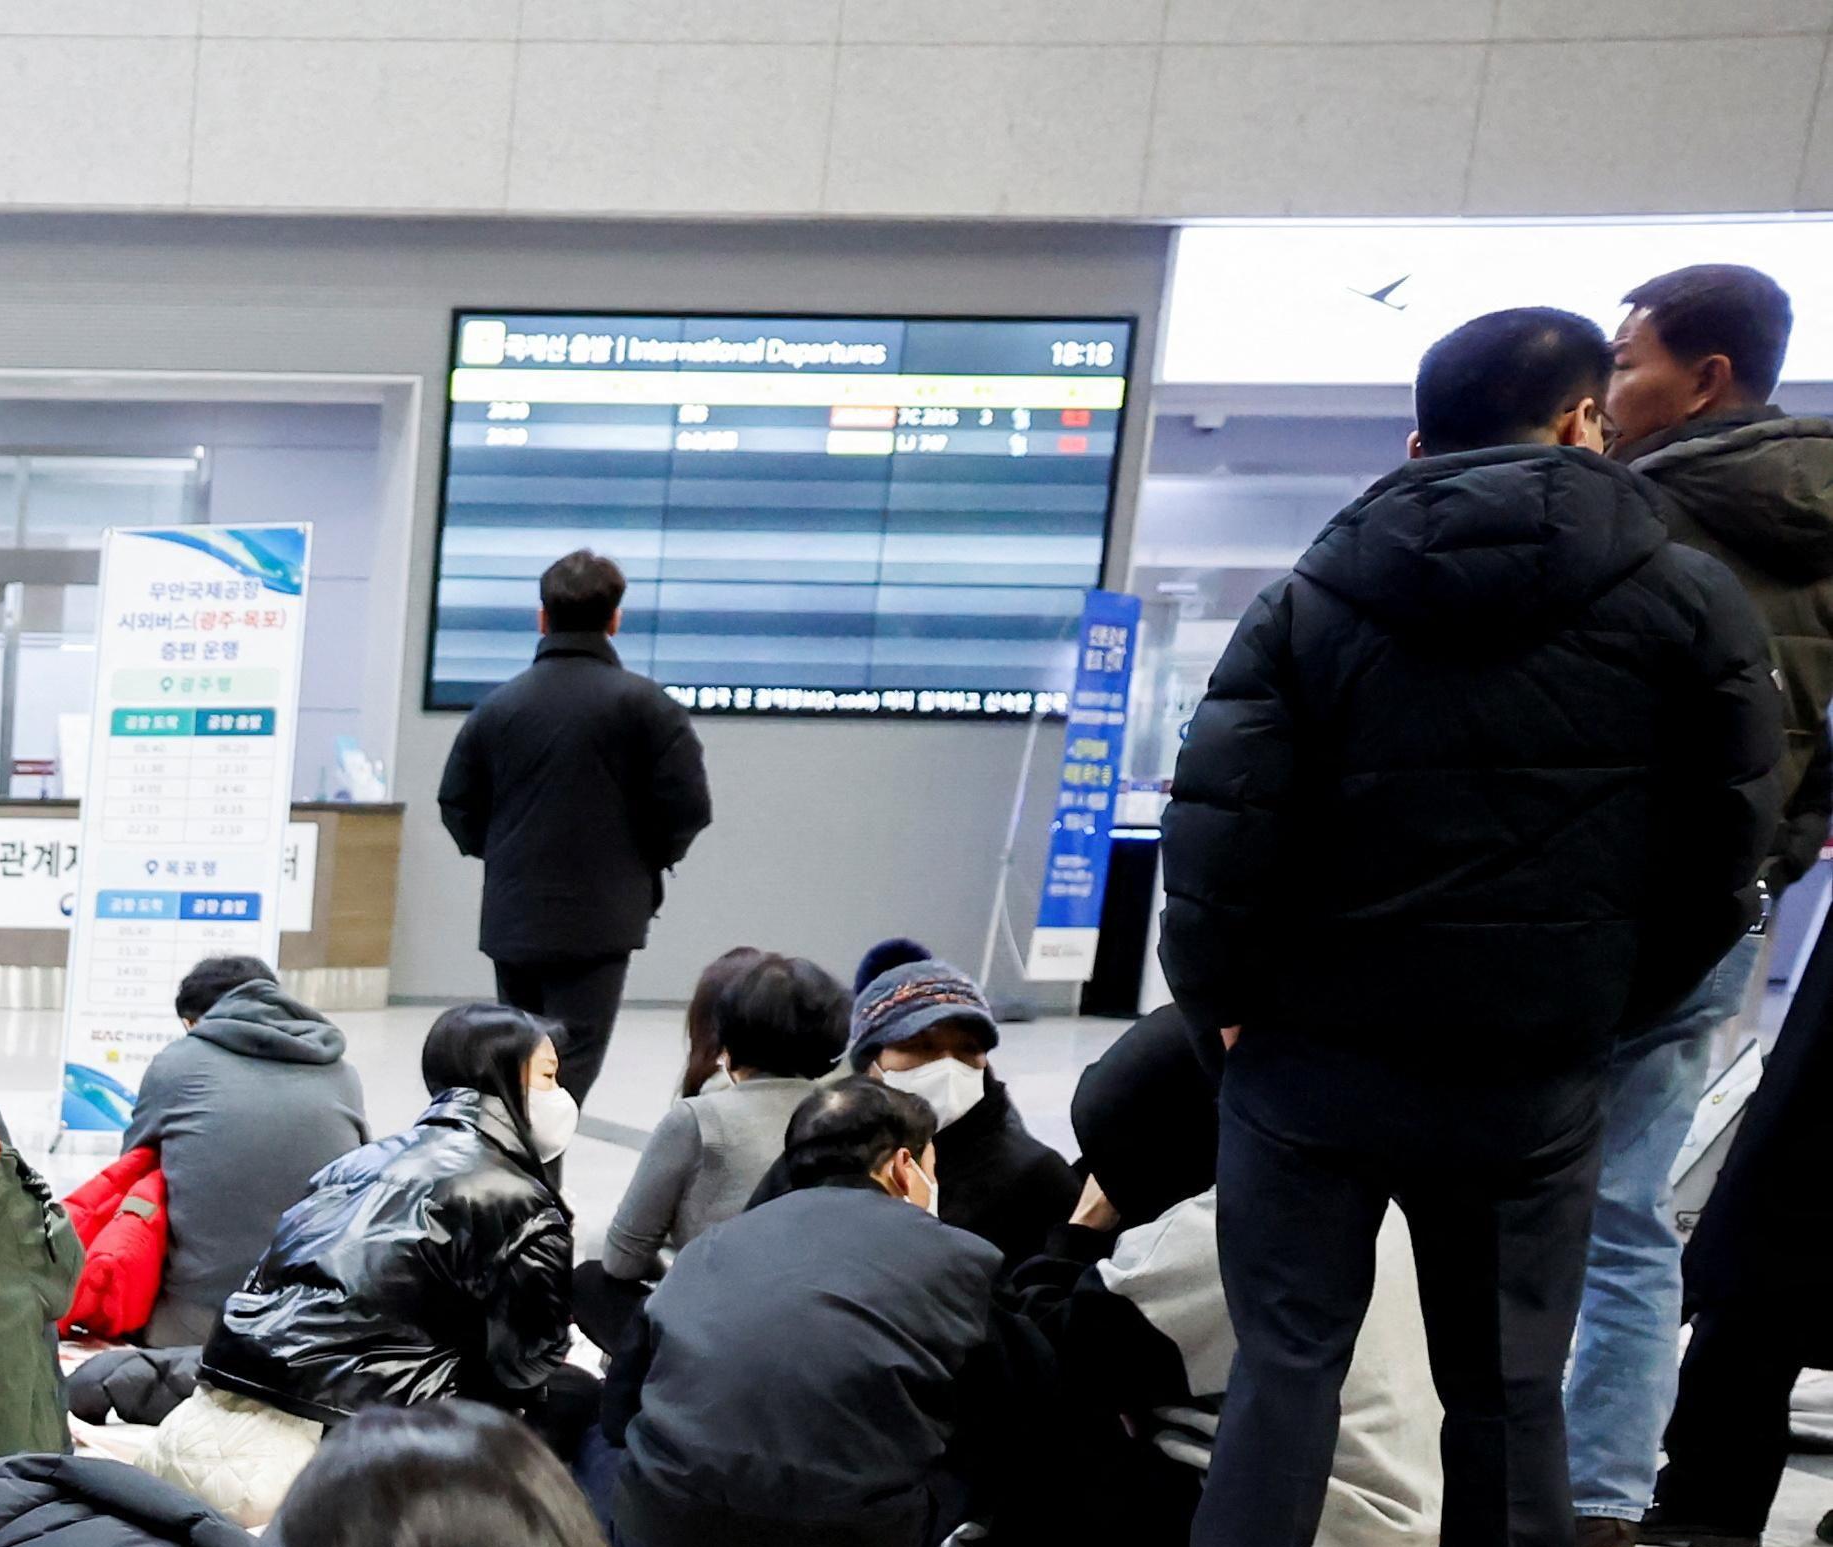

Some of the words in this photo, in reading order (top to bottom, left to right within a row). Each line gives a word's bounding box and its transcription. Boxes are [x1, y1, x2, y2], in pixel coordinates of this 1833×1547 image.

[628, 336, 766, 363] International
[766, 338, 887, 369] Departures
[1051, 341, 1114, 367] 18:18
[149, 581, 260, 601] 무안국제공항
[161, 641, 197, 662] 증편
[202, 640, 240, 661] 운행
